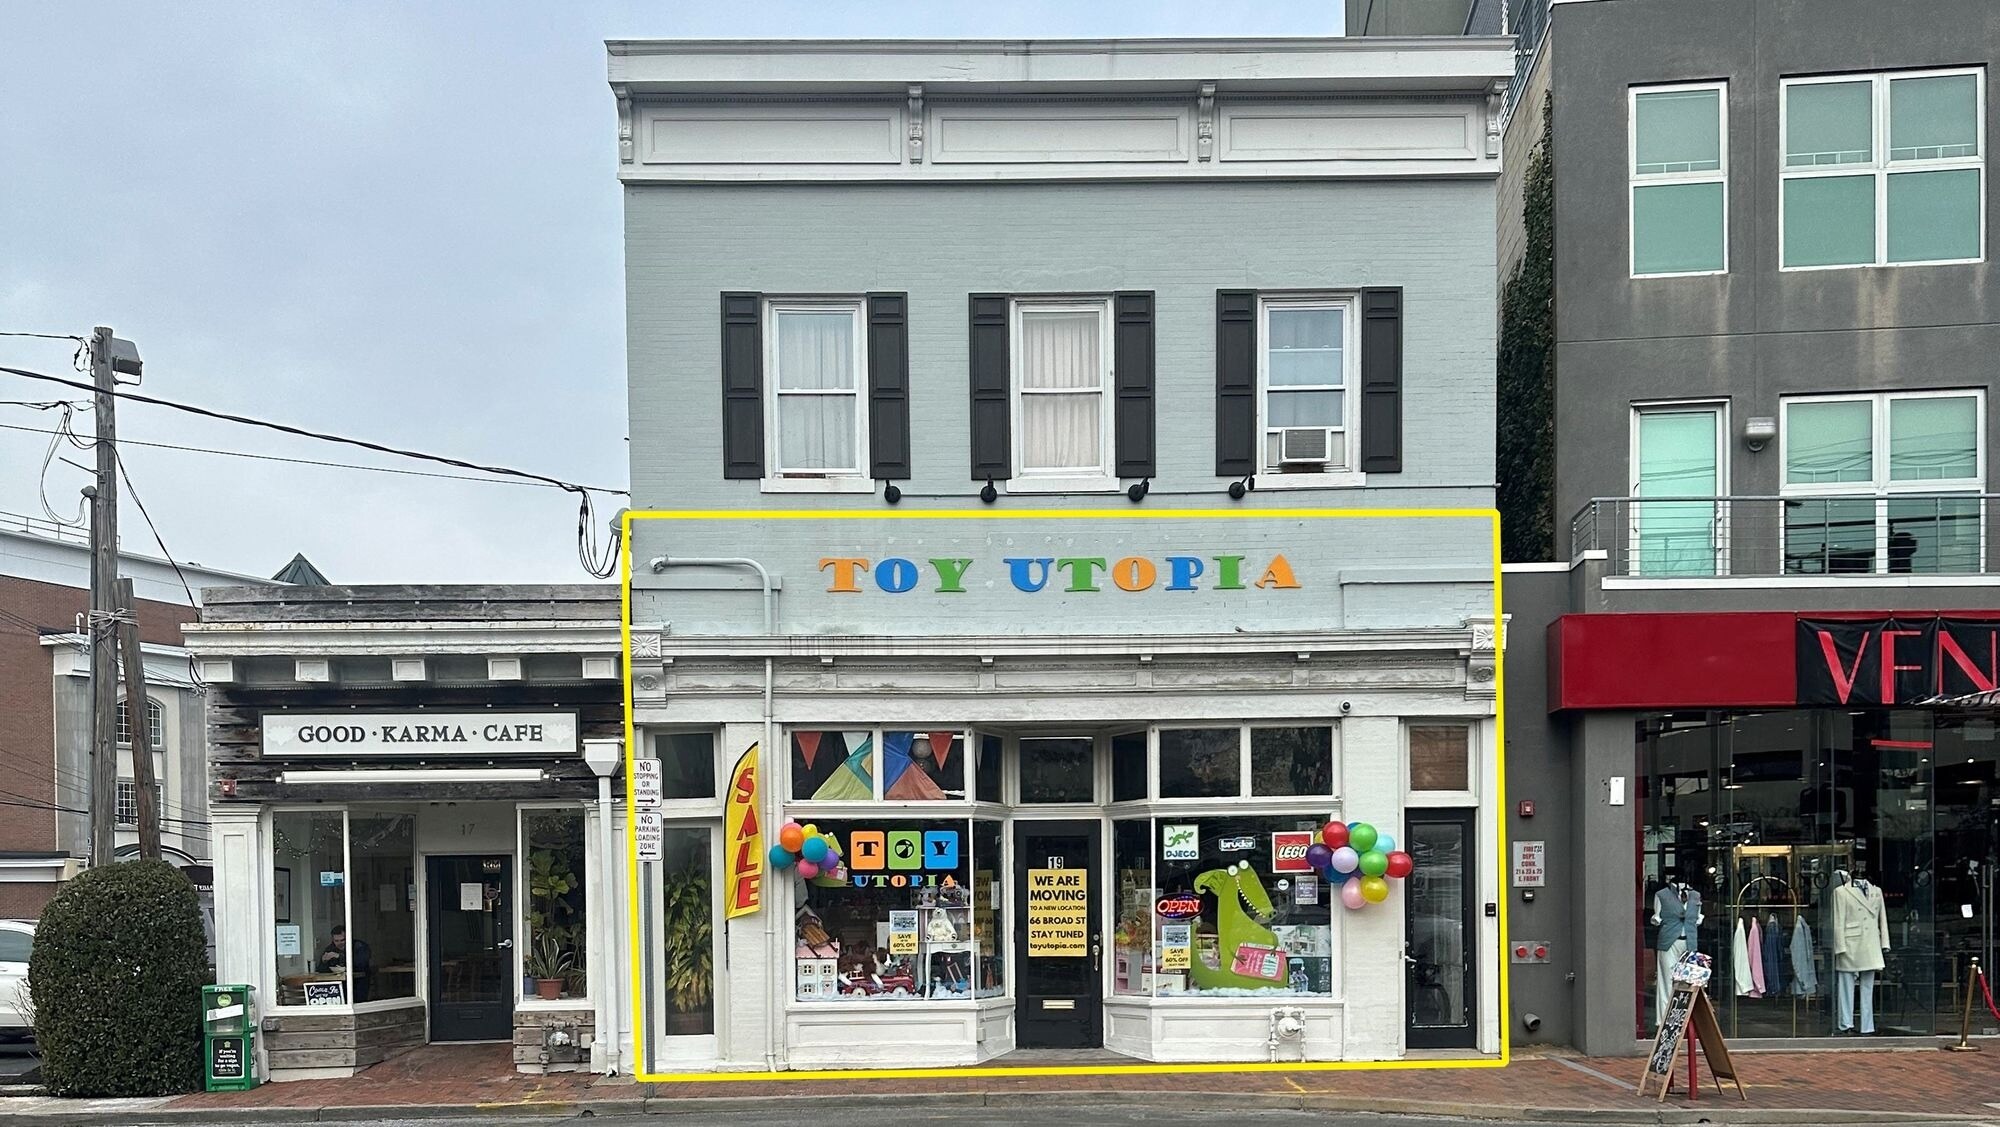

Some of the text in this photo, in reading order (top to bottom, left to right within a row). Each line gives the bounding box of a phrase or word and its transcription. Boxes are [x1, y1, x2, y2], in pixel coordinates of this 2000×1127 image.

[818, 553, 1302, 594] TOY UTOPIA
[298, 724, 543, 743] GOOD KARMA CAFE
[639, 762, 652, 771] NO
[633, 772, 659, 780] STOPPING
[640, 815, 653, 824] NO
[462, 823, 476, 836] 17
[634, 825, 660, 833] PARKING
[634, 833, 660, 841] LOADING
[736, 767, 760, 909] SALE
[639, 842, 656, 850] ZONE
[1219, 838, 1254, 850] bruder
[1165, 850, 1197, 858] DJECO
[1277, 844, 1307, 860] LEGO
[1049, 857, 1063, 869] 19
[852, 874, 955, 888] UTOPIA
[1034, 876, 1080, 886] WE ARE
[1030, 890, 1085, 901] MOVING
[1156, 899, 1201, 913] OPEN
[1030, 917, 1086, 925] 66 BROAD ST
[1031, 931, 1084, 939] STAY TUNED
[1030, 942, 1086, 950] toyutopia.com
[309, 985, 339, 996] Come In
[310, 996, 341, 1005] OPEN
